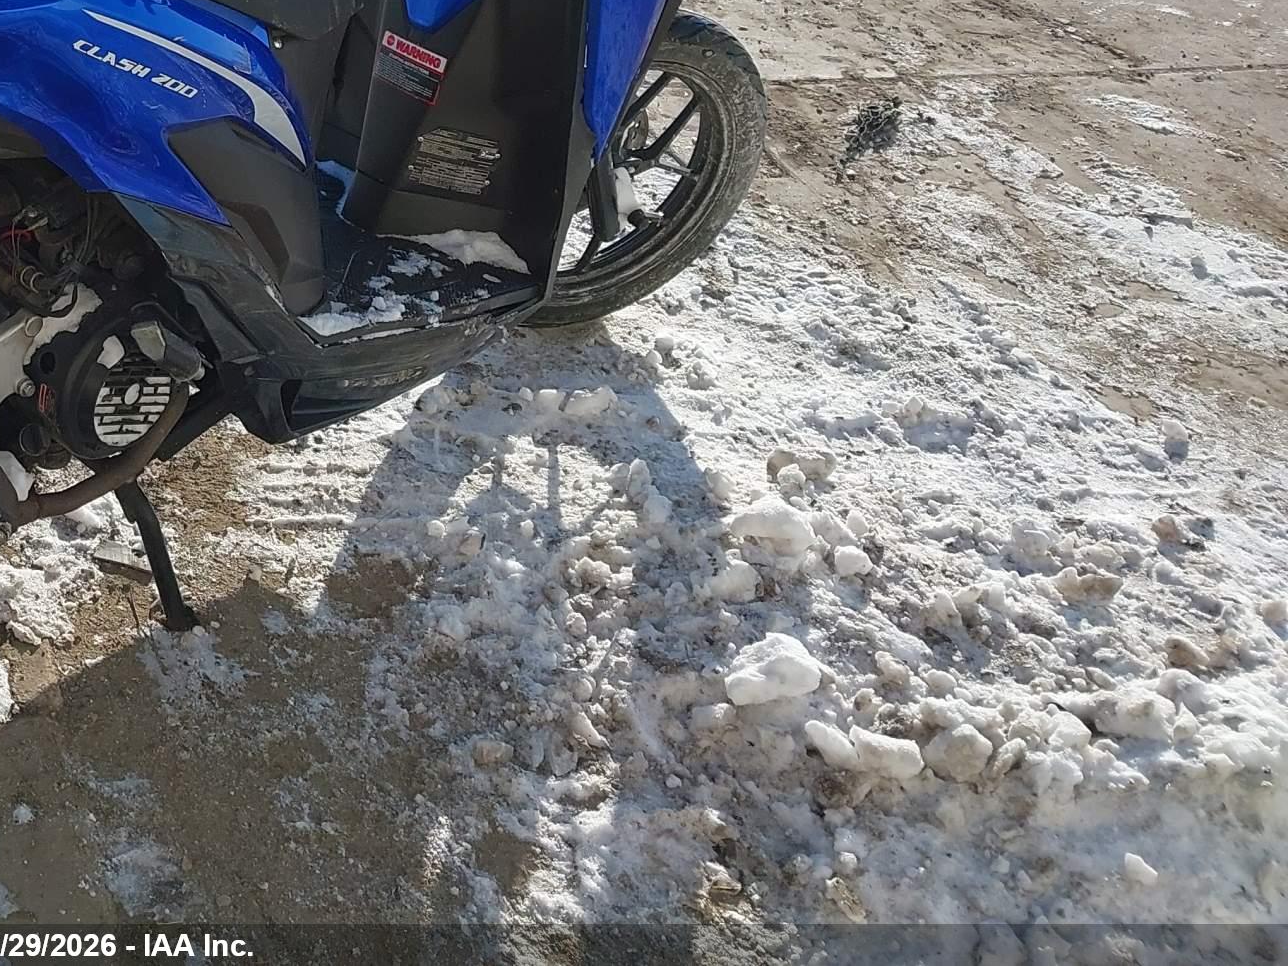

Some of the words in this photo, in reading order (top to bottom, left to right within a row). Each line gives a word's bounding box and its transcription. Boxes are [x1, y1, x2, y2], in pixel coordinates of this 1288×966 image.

[72, 39, 152, 78] CLASH
[151, 73, 199, 99] 200
[395, 38, 442, 70] WARNING
